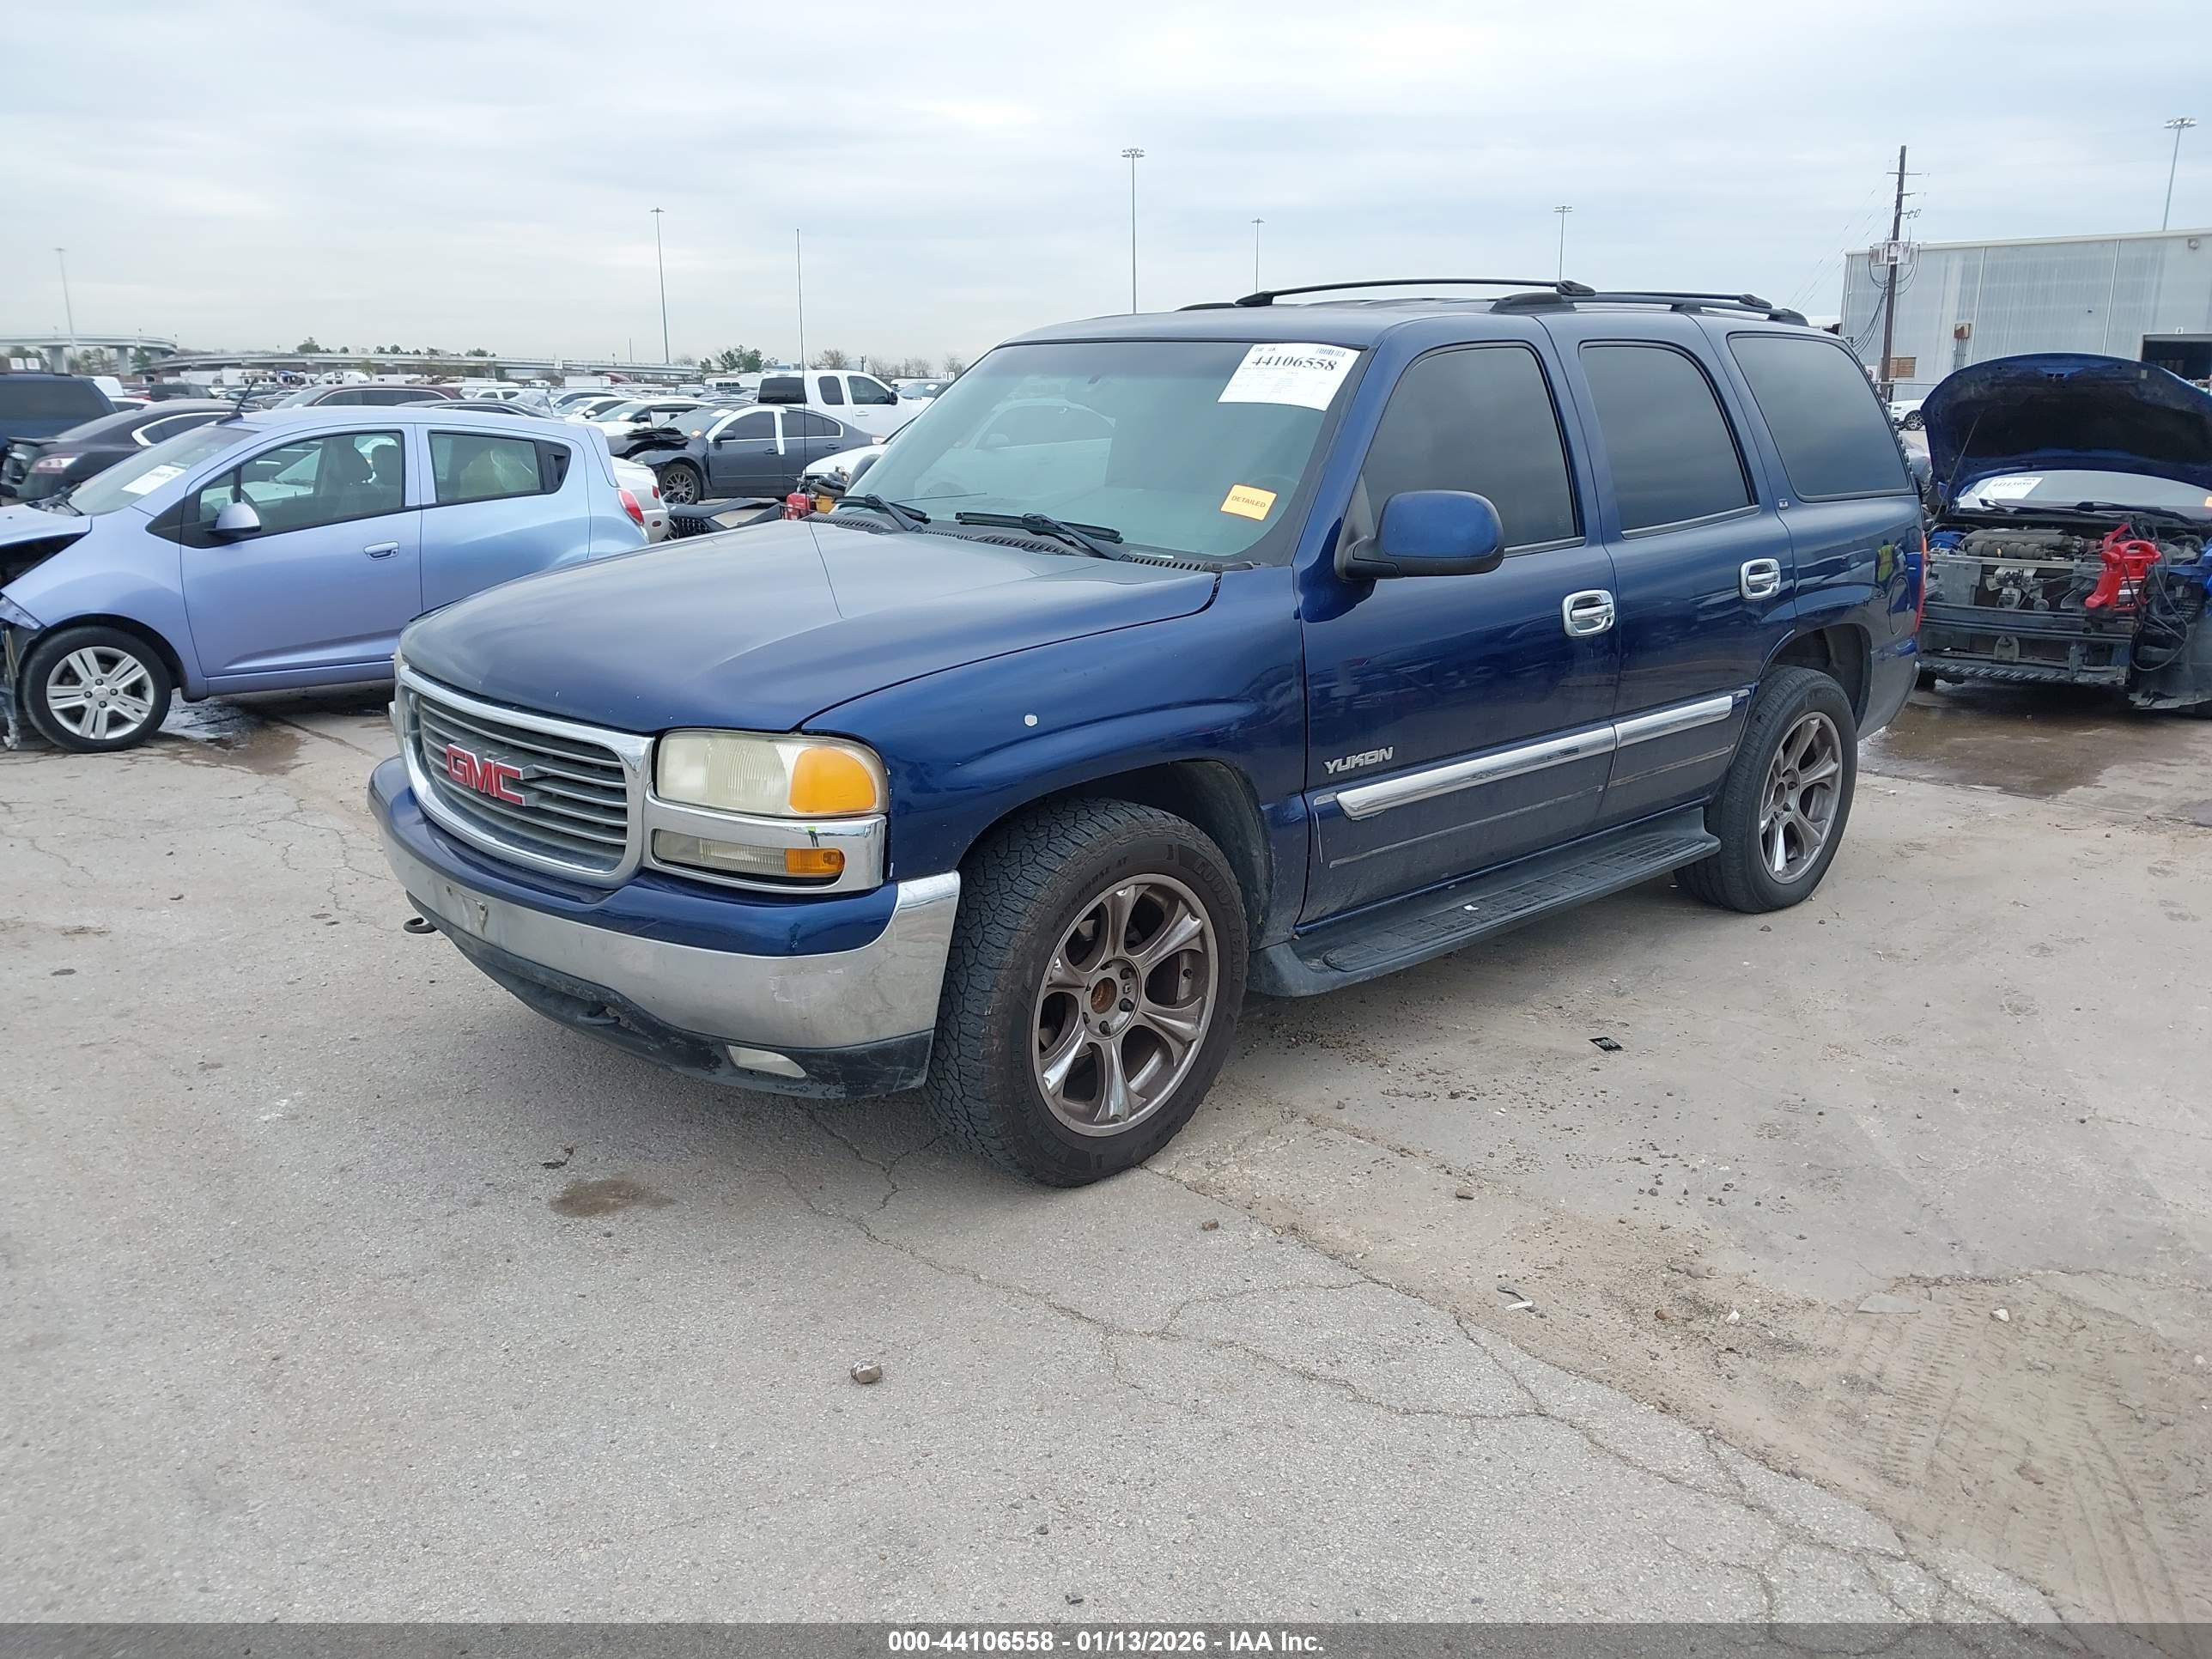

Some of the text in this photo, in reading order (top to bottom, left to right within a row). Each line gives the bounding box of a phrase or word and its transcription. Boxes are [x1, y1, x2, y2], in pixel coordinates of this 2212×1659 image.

[1251, 356, 1337, 371] 44106558
[1231, 495, 1267, 508] DETAILED
[1323, 746, 1394, 775] YUKON
[447, 743, 527, 806] GMC
